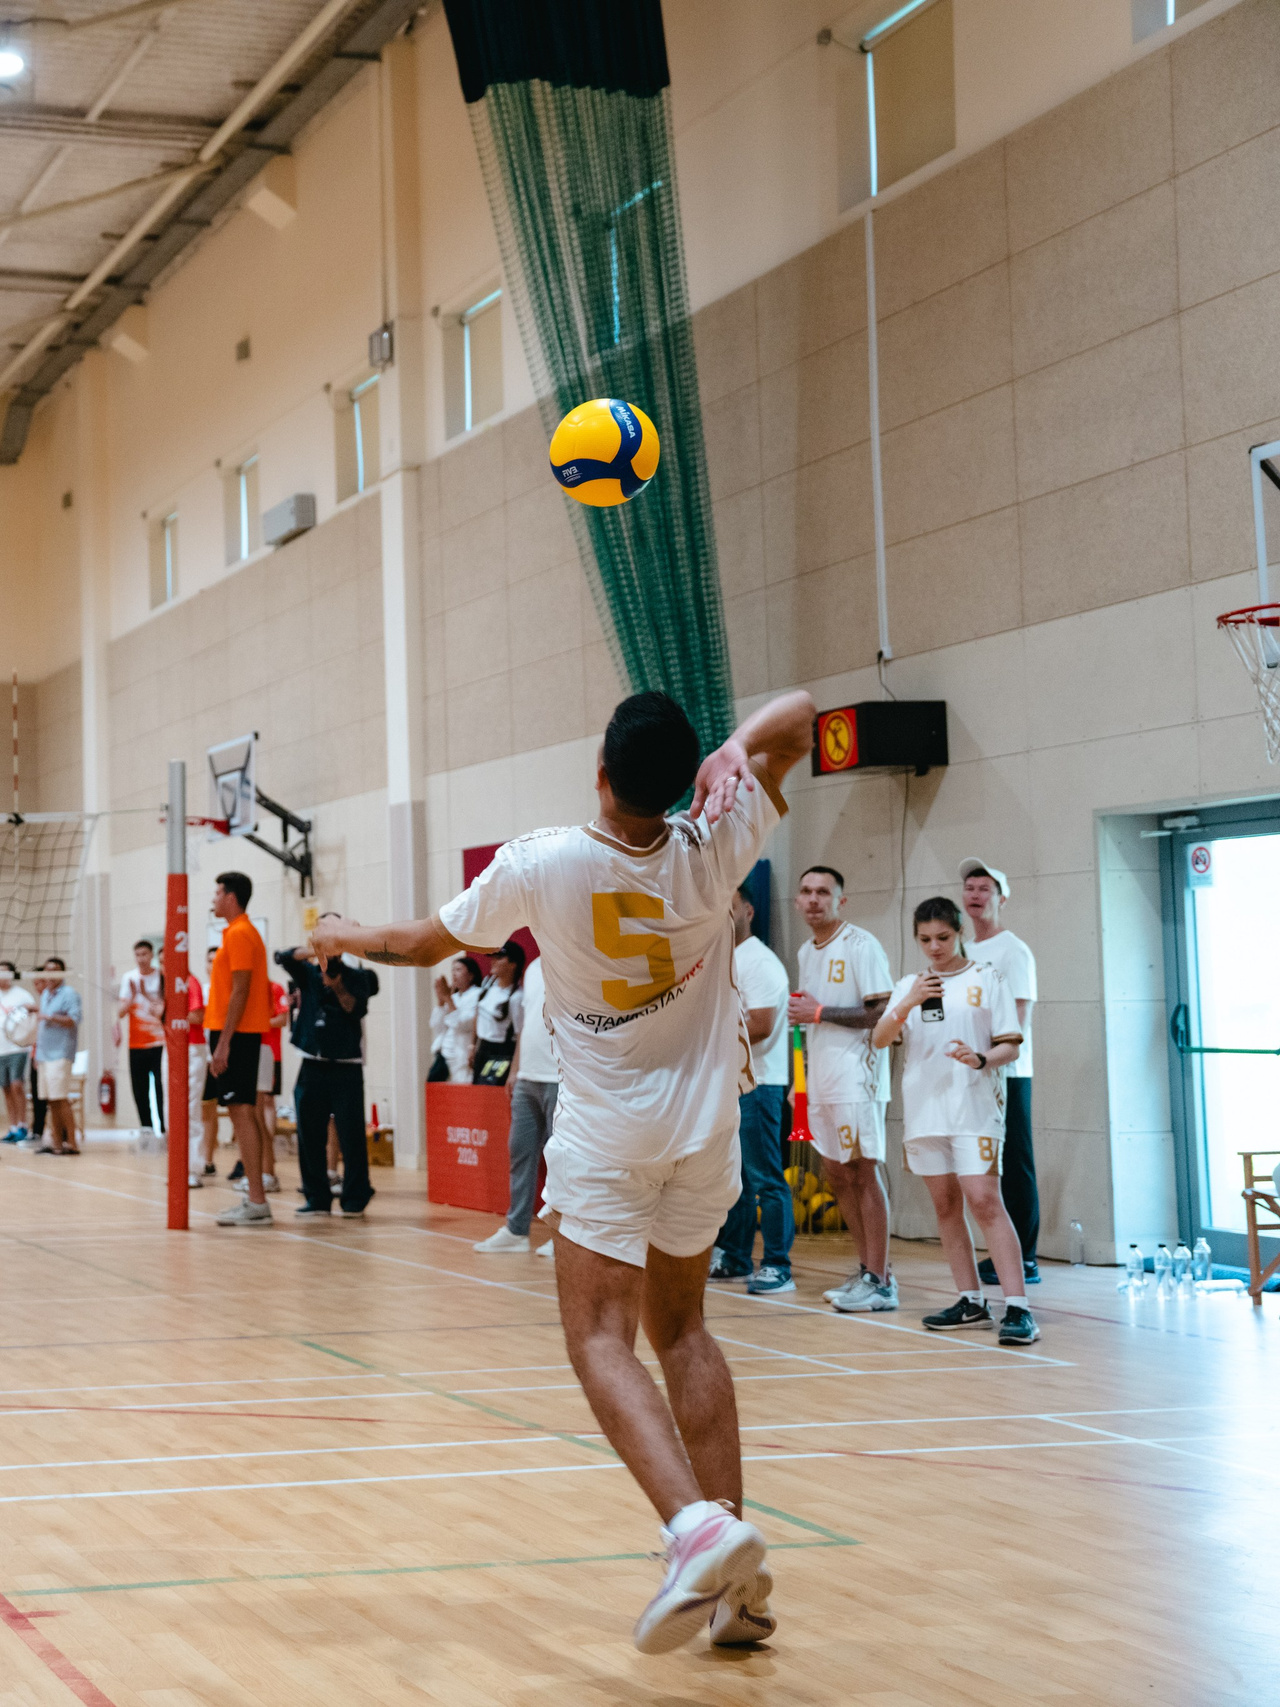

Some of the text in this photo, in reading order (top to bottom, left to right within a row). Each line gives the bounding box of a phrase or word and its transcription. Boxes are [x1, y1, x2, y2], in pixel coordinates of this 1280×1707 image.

[592, 892, 676, 1011] 5
[828, 959, 846, 983] 13
[968, 986, 982, 1008] 8
[978, 1137, 995, 1162] 8
